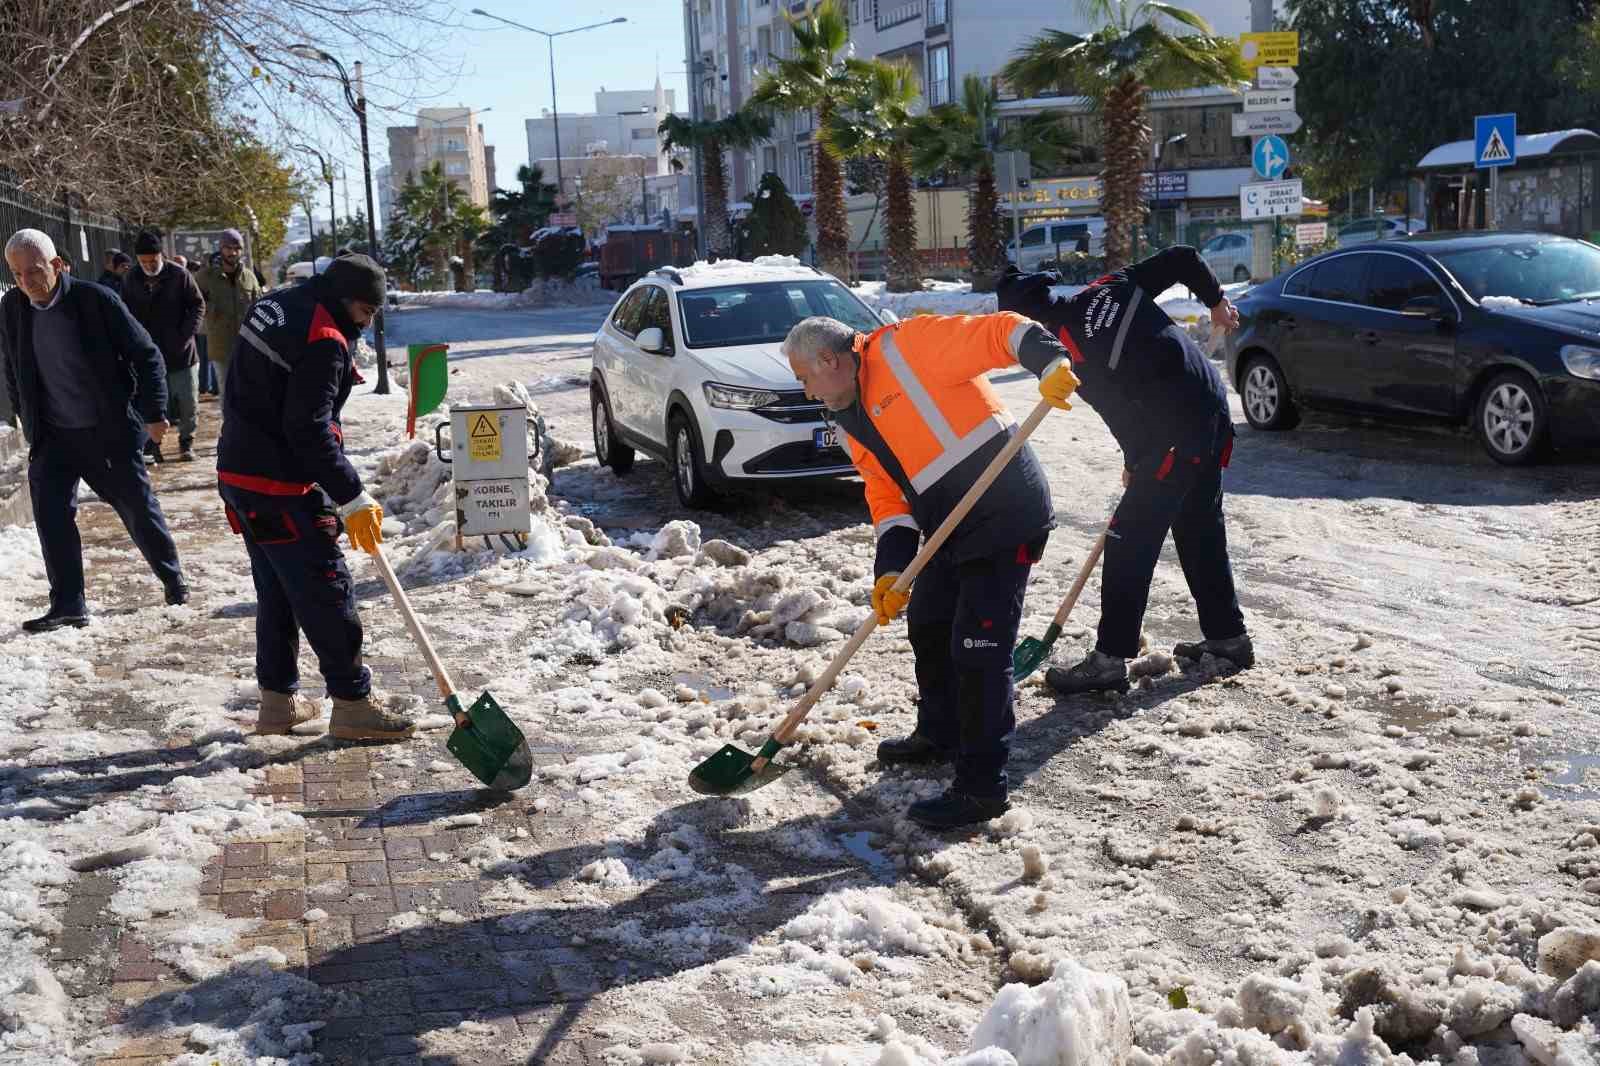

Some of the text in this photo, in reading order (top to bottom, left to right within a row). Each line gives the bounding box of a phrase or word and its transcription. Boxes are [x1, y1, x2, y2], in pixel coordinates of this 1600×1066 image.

[1247, 95, 1278, 106] BELEDİYE
[1269, 188, 1293, 198] ZİRAAT
[1263, 196, 1300, 206] FAKÜLTESİ
